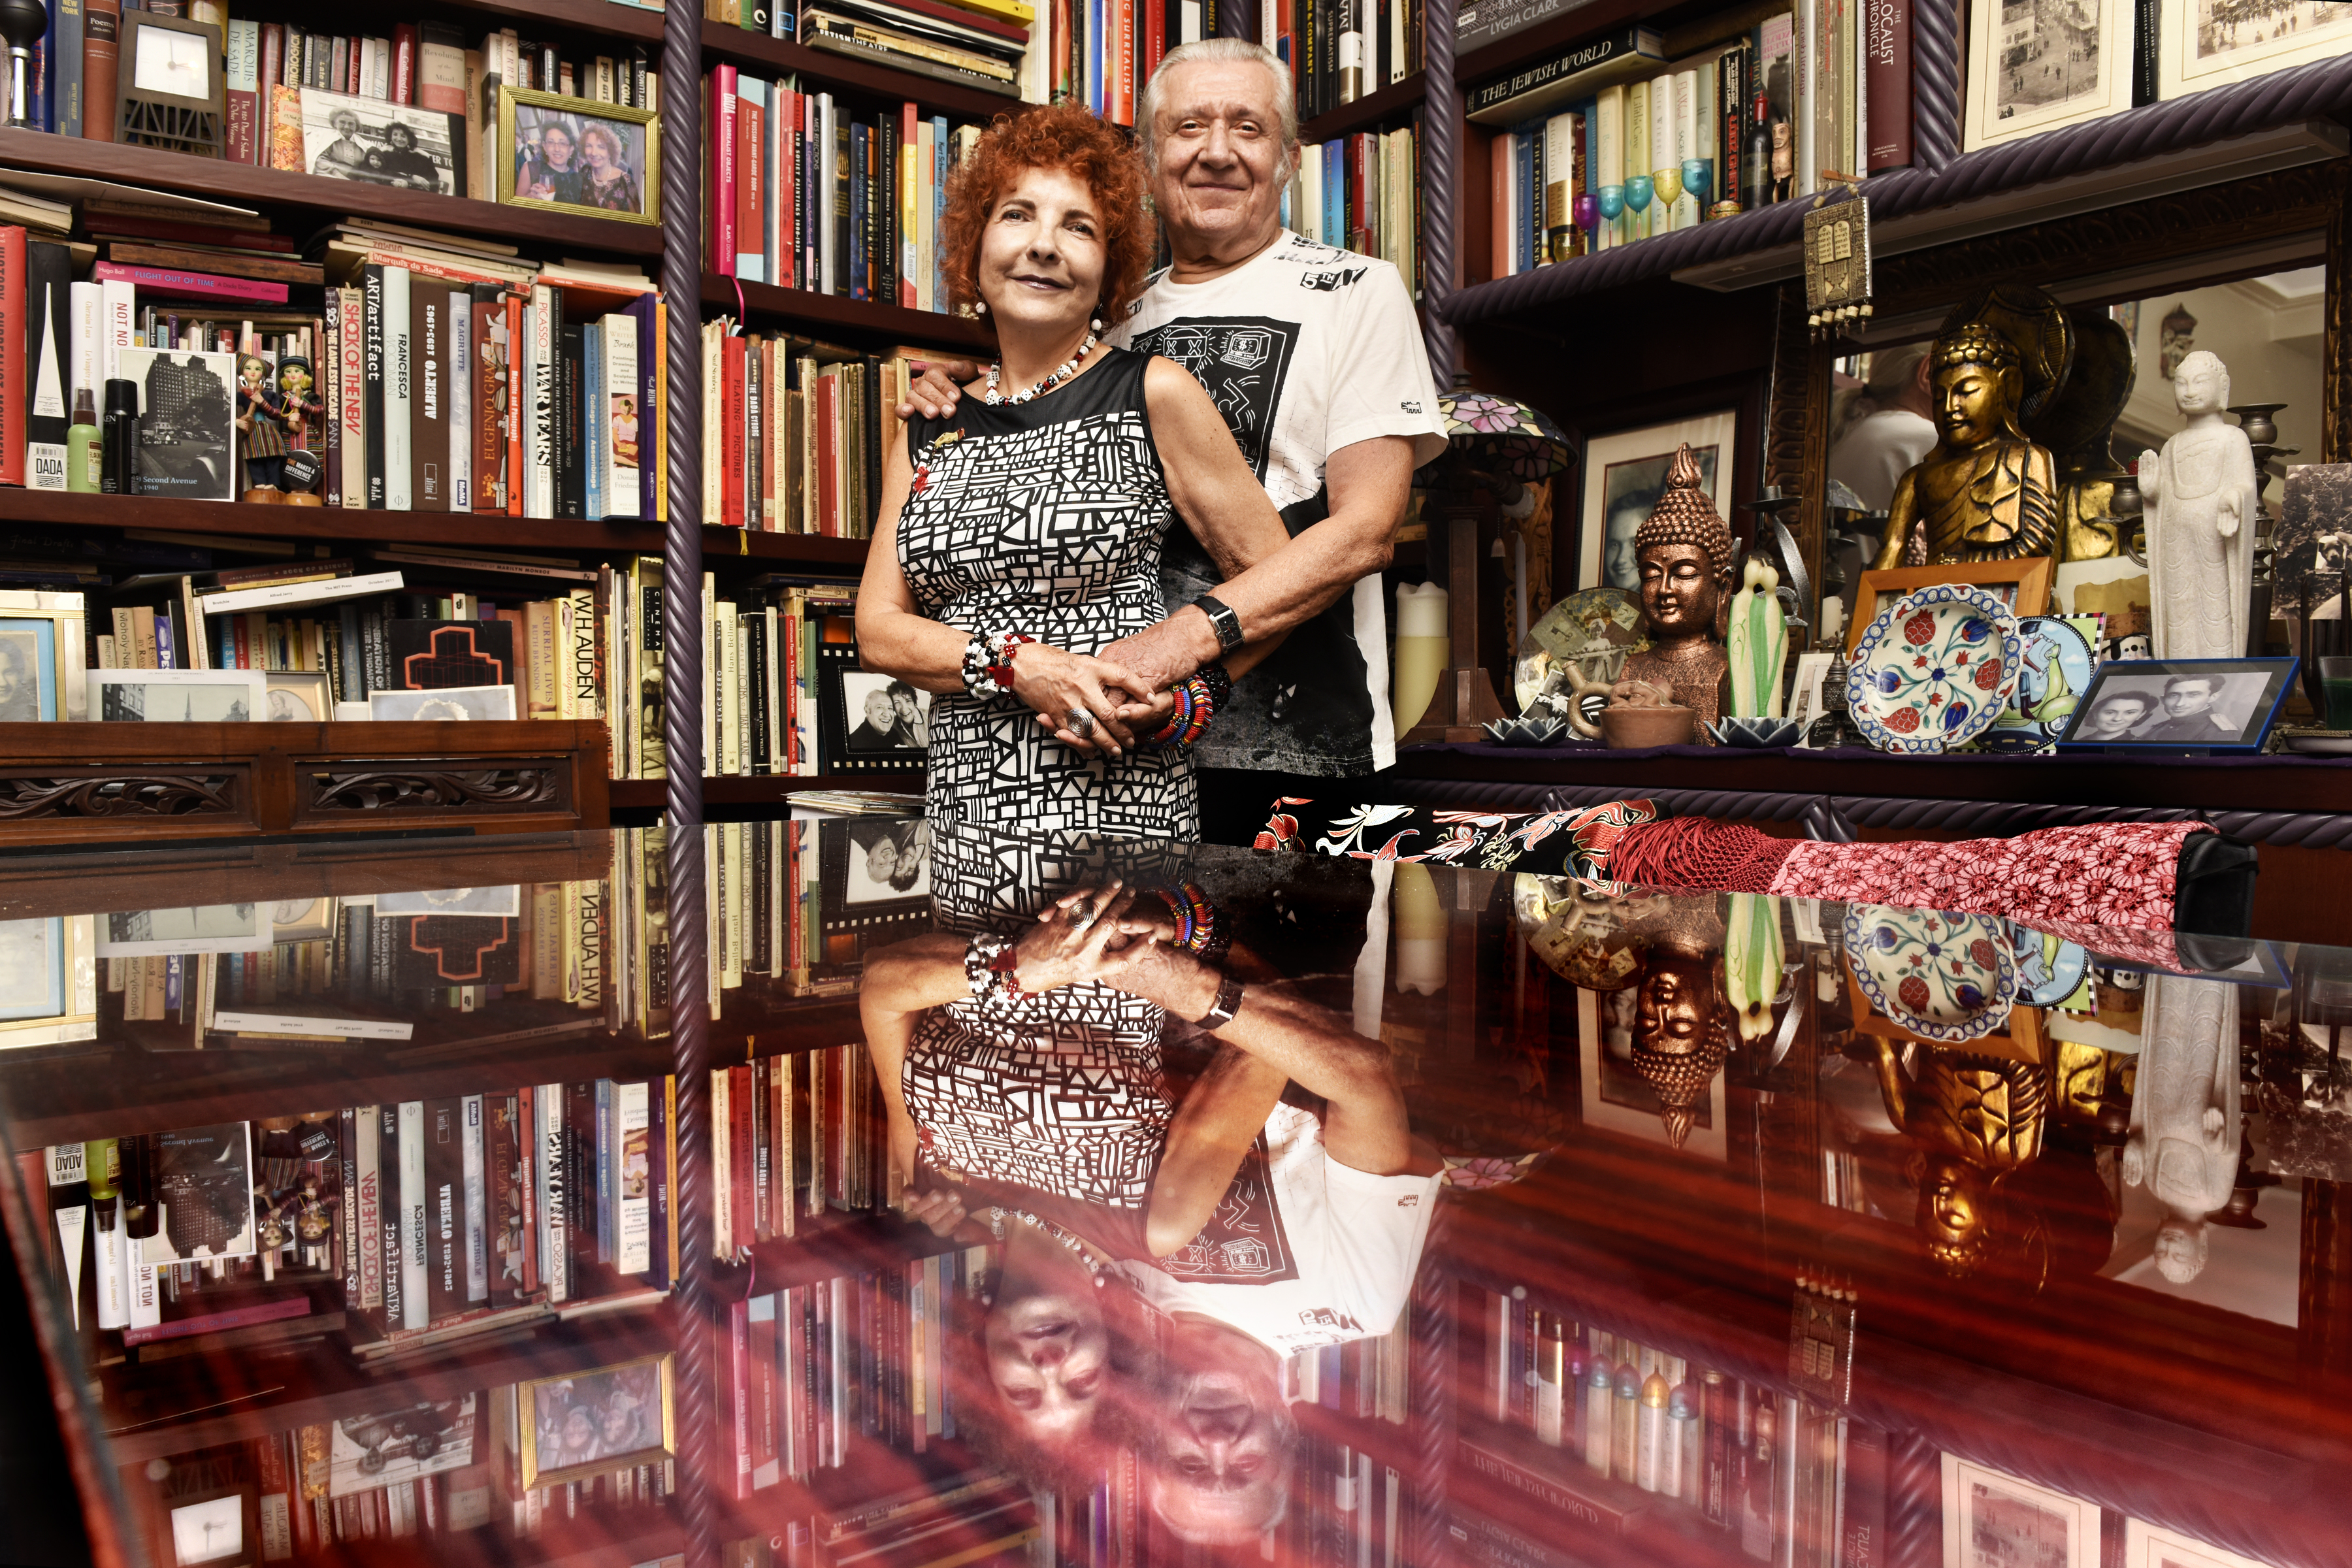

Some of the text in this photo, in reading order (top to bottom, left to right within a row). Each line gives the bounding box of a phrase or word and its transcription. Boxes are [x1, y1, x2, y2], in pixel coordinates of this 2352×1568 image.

[61, 6, 78, 16] YORK
[90, 17, 114, 28] Poems
[1461, 14, 1475, 24] MoMA
[1490, 0, 1560, 35] LYGIA CLARK
[229, 28, 256, 82] MARQUIS DE SADE
[425, 48, 463, 61] Revolution
[436, 74, 455, 83] Mind
[1482, 83, 1507, 103] THE
[1509, 61, 1560, 96] JEWISH
[1561, 41, 1612, 72] WORLD
[723, 93, 736, 114] DADA
[228, 122, 238, 145] Writings
[1633, 95, 1643, 149] Lilith's Cave
[99, 267, 114, 275] Hugo
[374, 253, 444, 276] Marquis de Sade
[135, 270, 162, 281] FLIGHT
[165, 274, 181, 283] OUT
[184, 276, 194, 284] OF
[197, 278, 214, 287] TIME
[116, 302, 128, 324] NOT
[367, 274, 382, 381] ART/artifact
[614, 340, 635, 350] Brush
[344, 304, 360, 436] SHOCK OF THE NEW
[386, 335, 397, 396] WOODMAN
[398, 333, 408, 399] FRANCESCA
[327, 329, 338, 448] THE LAWLESS DECADE SANN
[425, 360, 437, 419] ALBERTO
[537, 302, 550, 465] PICASSO WAR YEARS
[749, 396, 758, 414] DADA
[484, 398, 495, 460] EUGENIO
[751, 416, 759, 436] CYBORG
[36, 458, 63, 476] DADA
[285, 465, 312, 480] DIFFERENCE
[295, 461, 312, 473] MAKES
[574, 594, 595, 699] W.H.AUDEN
[542, 615, 553, 702] SURREAL LIVES
[738, 674, 747, 700] POEMS
[740, 714, 749, 730] HART
[740, 732, 749, 757] CRANE
